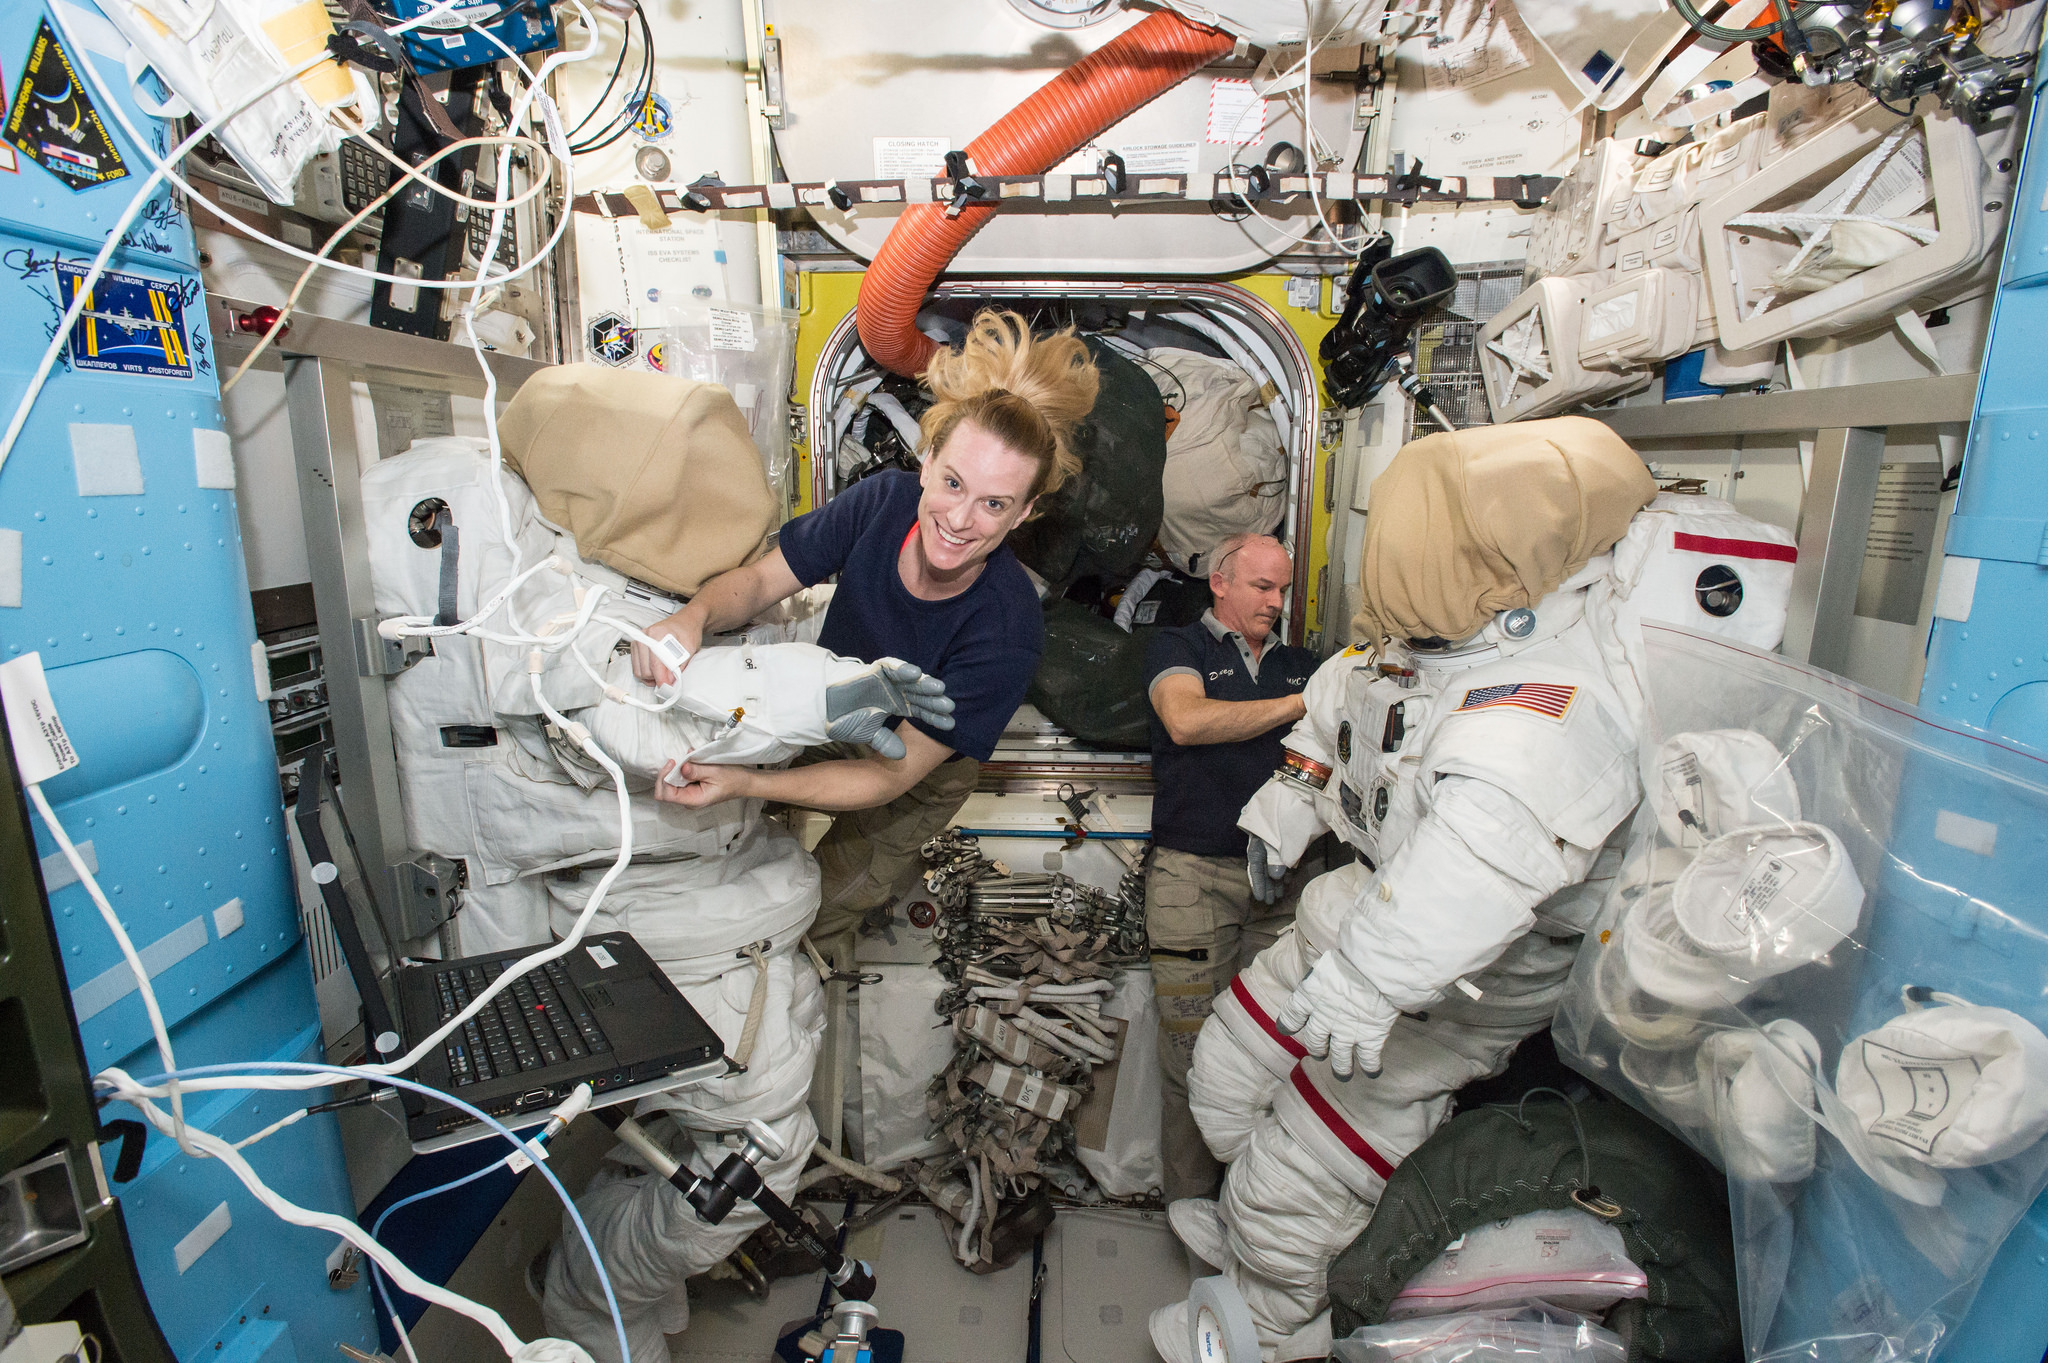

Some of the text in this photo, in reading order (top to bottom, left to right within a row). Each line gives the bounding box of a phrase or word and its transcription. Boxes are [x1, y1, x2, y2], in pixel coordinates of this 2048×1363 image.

[29, 35, 48, 74] WILLIAMS
[53, 43, 85, 95] ТАРЕЛКИН
[105, 168, 126, 180] FORD
[1468, 162, 1494, 170] ISOLATION
[112, 273, 144, 287] WILMORE
[76, 359, 118, 370] ШКАПЛЕРОВ
[122, 363, 143, 372] VIRTS
[147, 366, 192, 377] CRISTOFORETTI
[40, 721, 50, 738] A31p
[48, 723, 68, 762] Power Cable
[52, 715, 76, 765] To A31p Laptop
[47, 739, 65, 770] Enhanced
[1205, 1331, 1213, 1357] Shurtape
